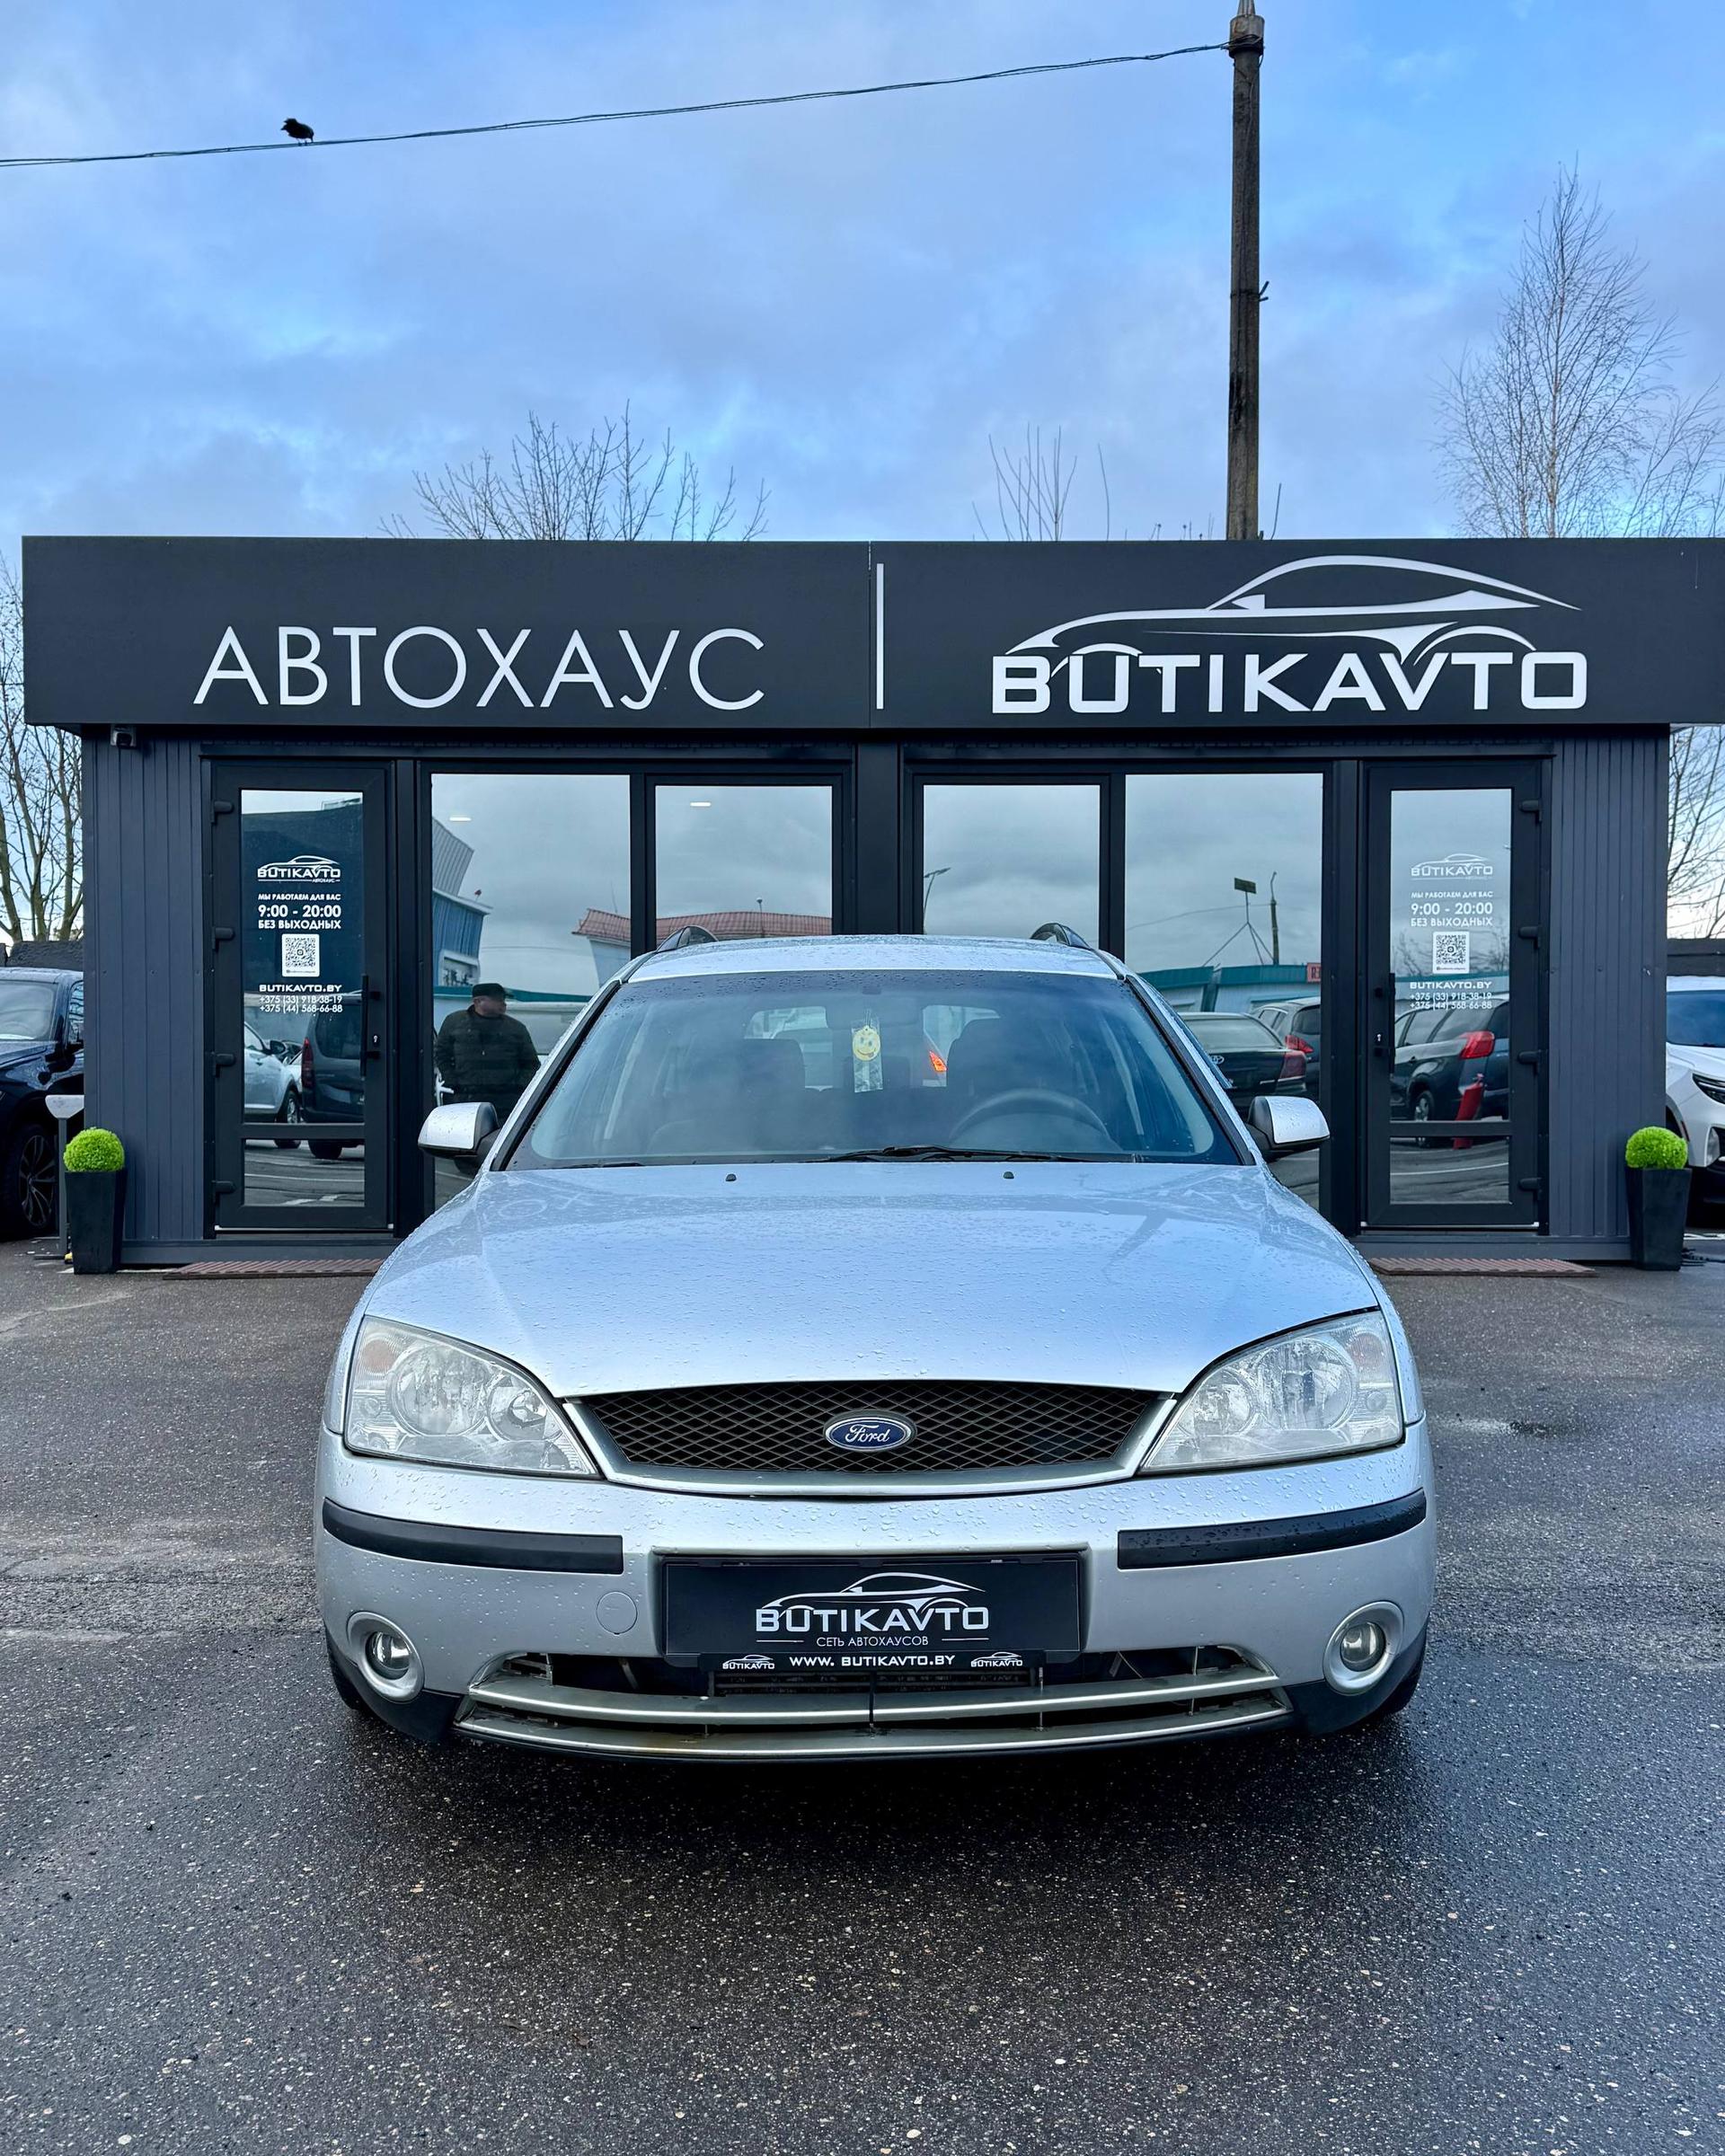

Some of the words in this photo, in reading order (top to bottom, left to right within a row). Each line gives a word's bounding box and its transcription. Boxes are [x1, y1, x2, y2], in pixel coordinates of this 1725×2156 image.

[193, 624, 764, 711] АВТОХАУС
[992, 649, 1588, 715] BUTIKAVTO
[257, 868, 341, 879] BUTIKAVTO
[1411, 866, 1493, 877] BUTIKAVTO
[258, 893, 271, 901] МЫ
[272, 893, 309, 901] РАБОТАЕМ
[310, 893, 324, 901] ДЛЯ
[325, 893, 341, 901] ВАС
[258, 905, 288, 917] 9:00
[302, 905, 341, 917] 20:00
[1411, 903, 1440, 915] 9:00
[1455, 902, 1493, 915] 20:00
[258, 920, 276, 929] БЕЗ
[278, 920, 341, 930] ВЫХОДНЫХ
[1411, 918, 1428, 927] БЕЗ
[1430, 917, 1493, 927] ВЫХОДНЫХ
[259, 984, 342, 992] BUTIKAVTO.BY
[1410, 981, 1492, 989] BUTIKAVTO.BY
[259, 994, 281, 1003] +375
[283, 994, 299, 1005] (33)
[301, 994, 342, 1003] 918-38-19
[1410, 992, 1430, 1001] +375
[1432, 992, 1448, 1003] (33)
[1451, 992, 1492, 1000] 918-38-19
[259, 1004, 281, 1012] +375
[283, 1004, 299, 1013] (44)
[301, 1004, 343, 1012] 568-66-88
[1432, 1001, 1448, 1011] (44)
[845, 1424, 891, 1443] Ford
[756, 1606, 989, 1632] BUTIKAVTO
[816, 1637, 845, 1647] СЕТЬ
[847, 1636, 929, 1646] АВТОХАУСОВ
[722, 1662, 775, 1670] BUTIKAVTO
[789, 1657, 835, 1667] WWW.
[841, 1655, 956, 1666] BUTIKAVTO.BY
[970, 1659, 1023, 1667] BUTIKAVTO
